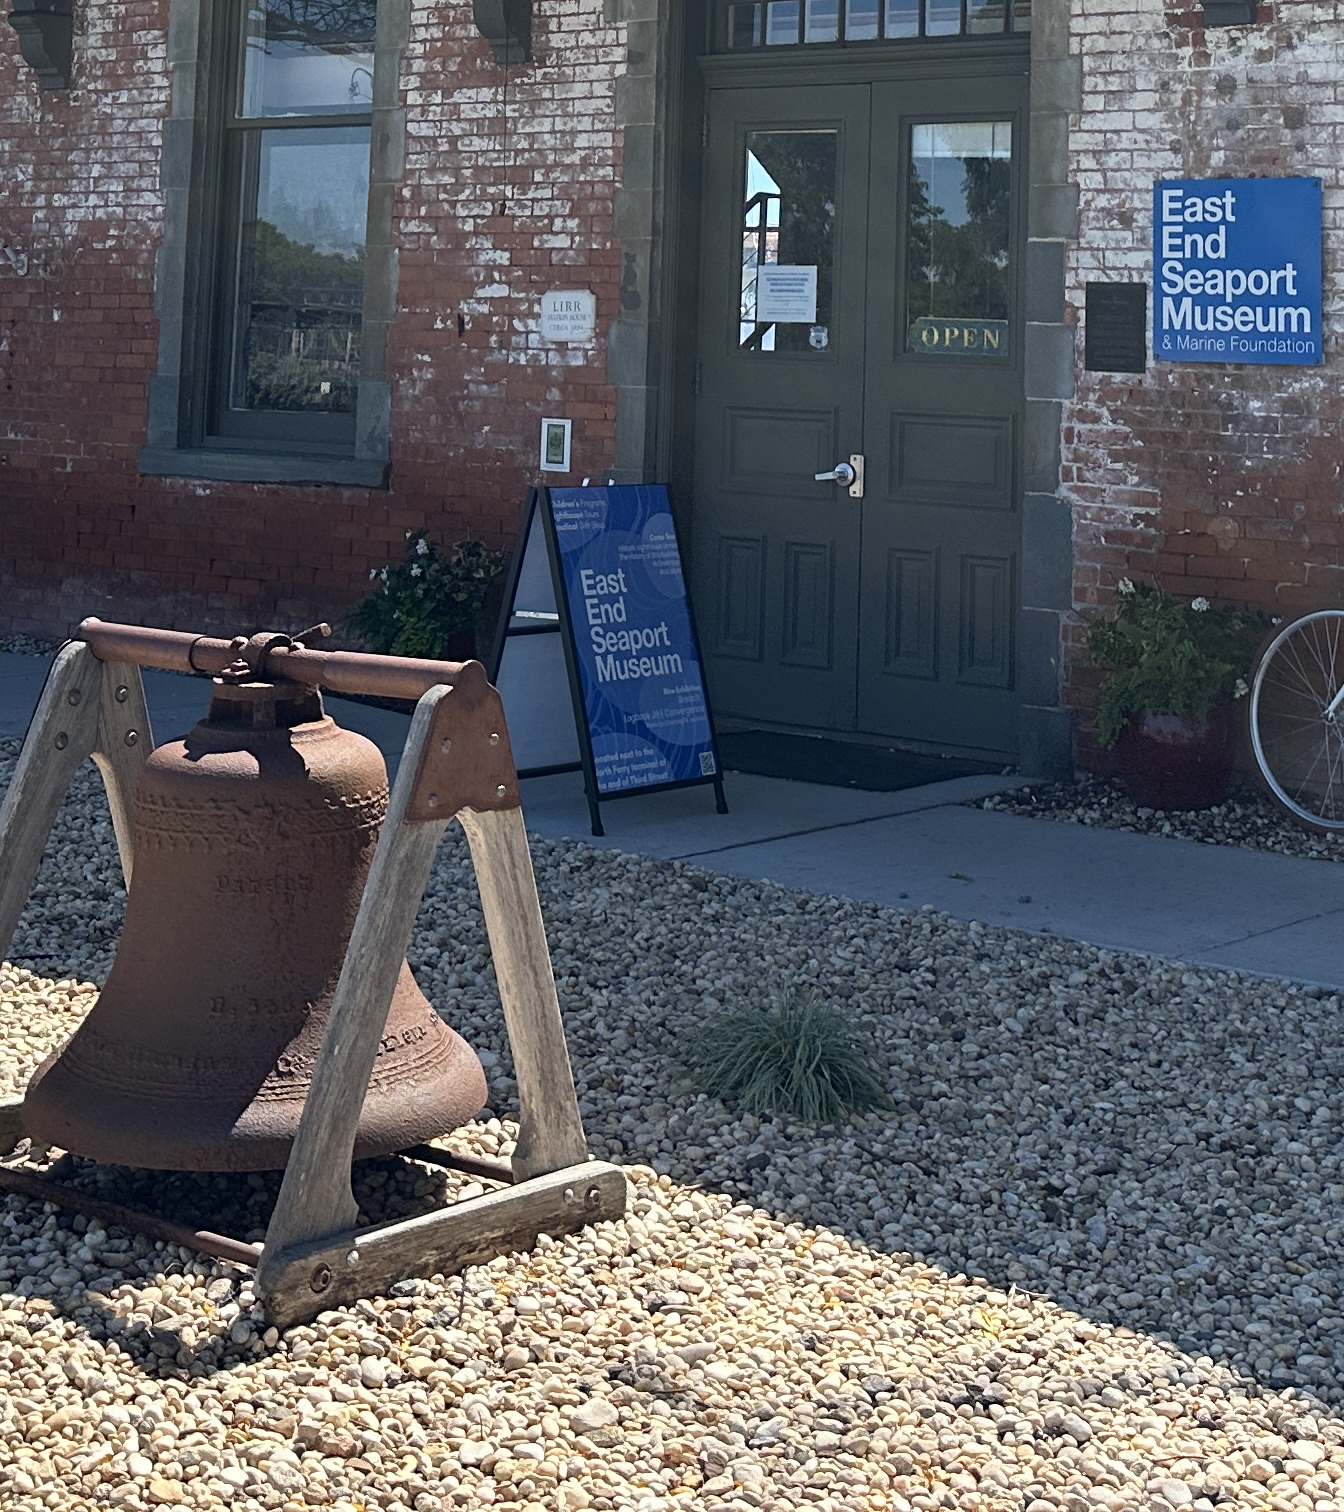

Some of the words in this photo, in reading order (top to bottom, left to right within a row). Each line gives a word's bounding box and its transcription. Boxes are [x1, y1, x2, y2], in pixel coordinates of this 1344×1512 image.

[1161, 189, 1236, 223] East
[1161, 225, 1226, 259] End
[1161, 260, 1297, 302] Seaport
[552, 301, 581, 313] LIRR
[1161, 296, 1311, 333] Museum
[921, 325, 1000, 349] OPEN
[1162, 335, 1173, 351] &
[1177, 335, 1226, 352] Marine
[1230, 336, 1315, 354] Foundation
[552, 498, 580, 508] hildren's
[553, 510, 584, 522] ighthouse
[580, 568, 628, 596] East
[585, 596, 627, 625] End
[590, 621, 671, 656] Seaport
[595, 653, 683, 683] Museum
[635, 748, 643, 757] to
